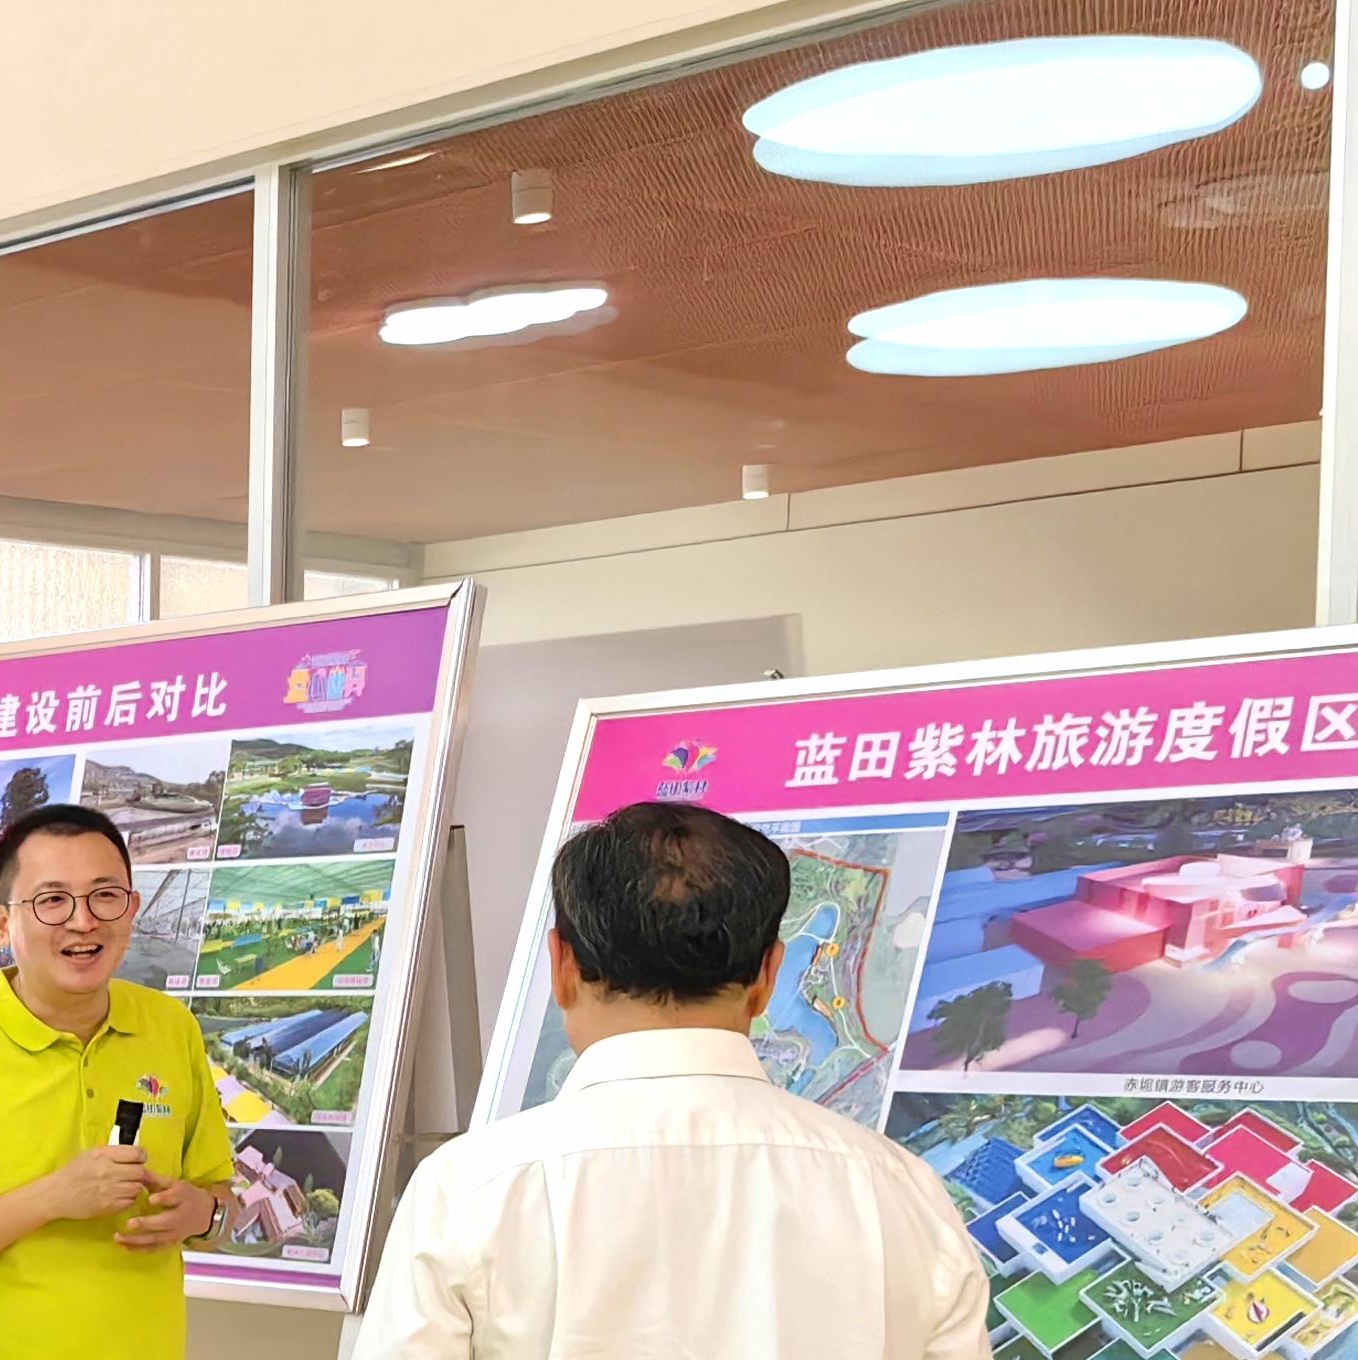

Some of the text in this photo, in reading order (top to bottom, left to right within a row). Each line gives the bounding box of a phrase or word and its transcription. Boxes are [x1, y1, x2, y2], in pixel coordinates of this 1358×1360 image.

[785, 693, 1358, 789] 蓝田紫林旅游度假区
